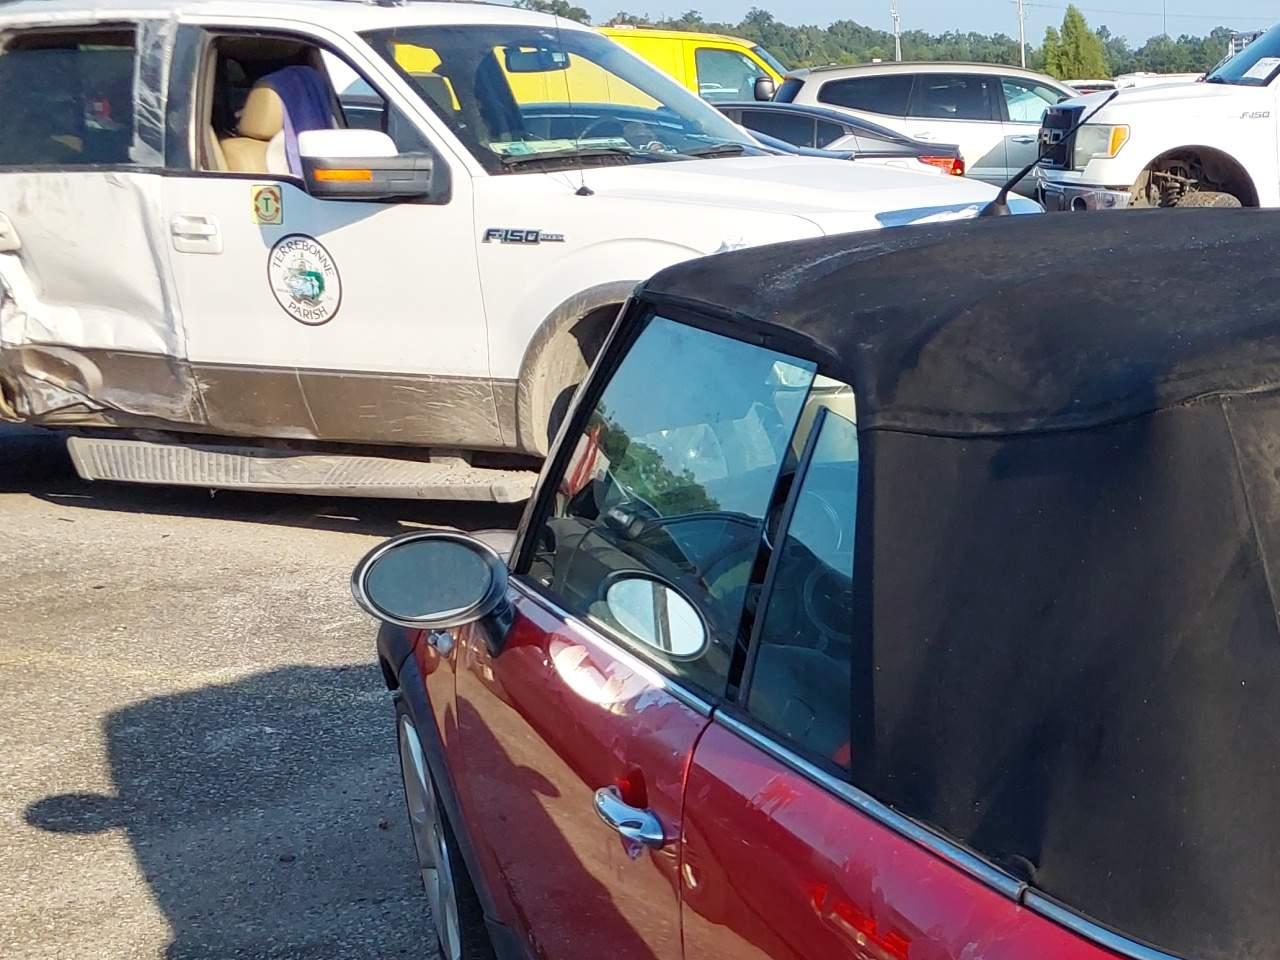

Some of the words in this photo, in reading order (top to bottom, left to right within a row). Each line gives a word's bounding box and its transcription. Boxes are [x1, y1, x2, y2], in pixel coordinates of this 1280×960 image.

[263, 197, 271, 212] T
[273, 239, 334, 276] TERREBONNE
[288, 301, 328, 320] PARISH
